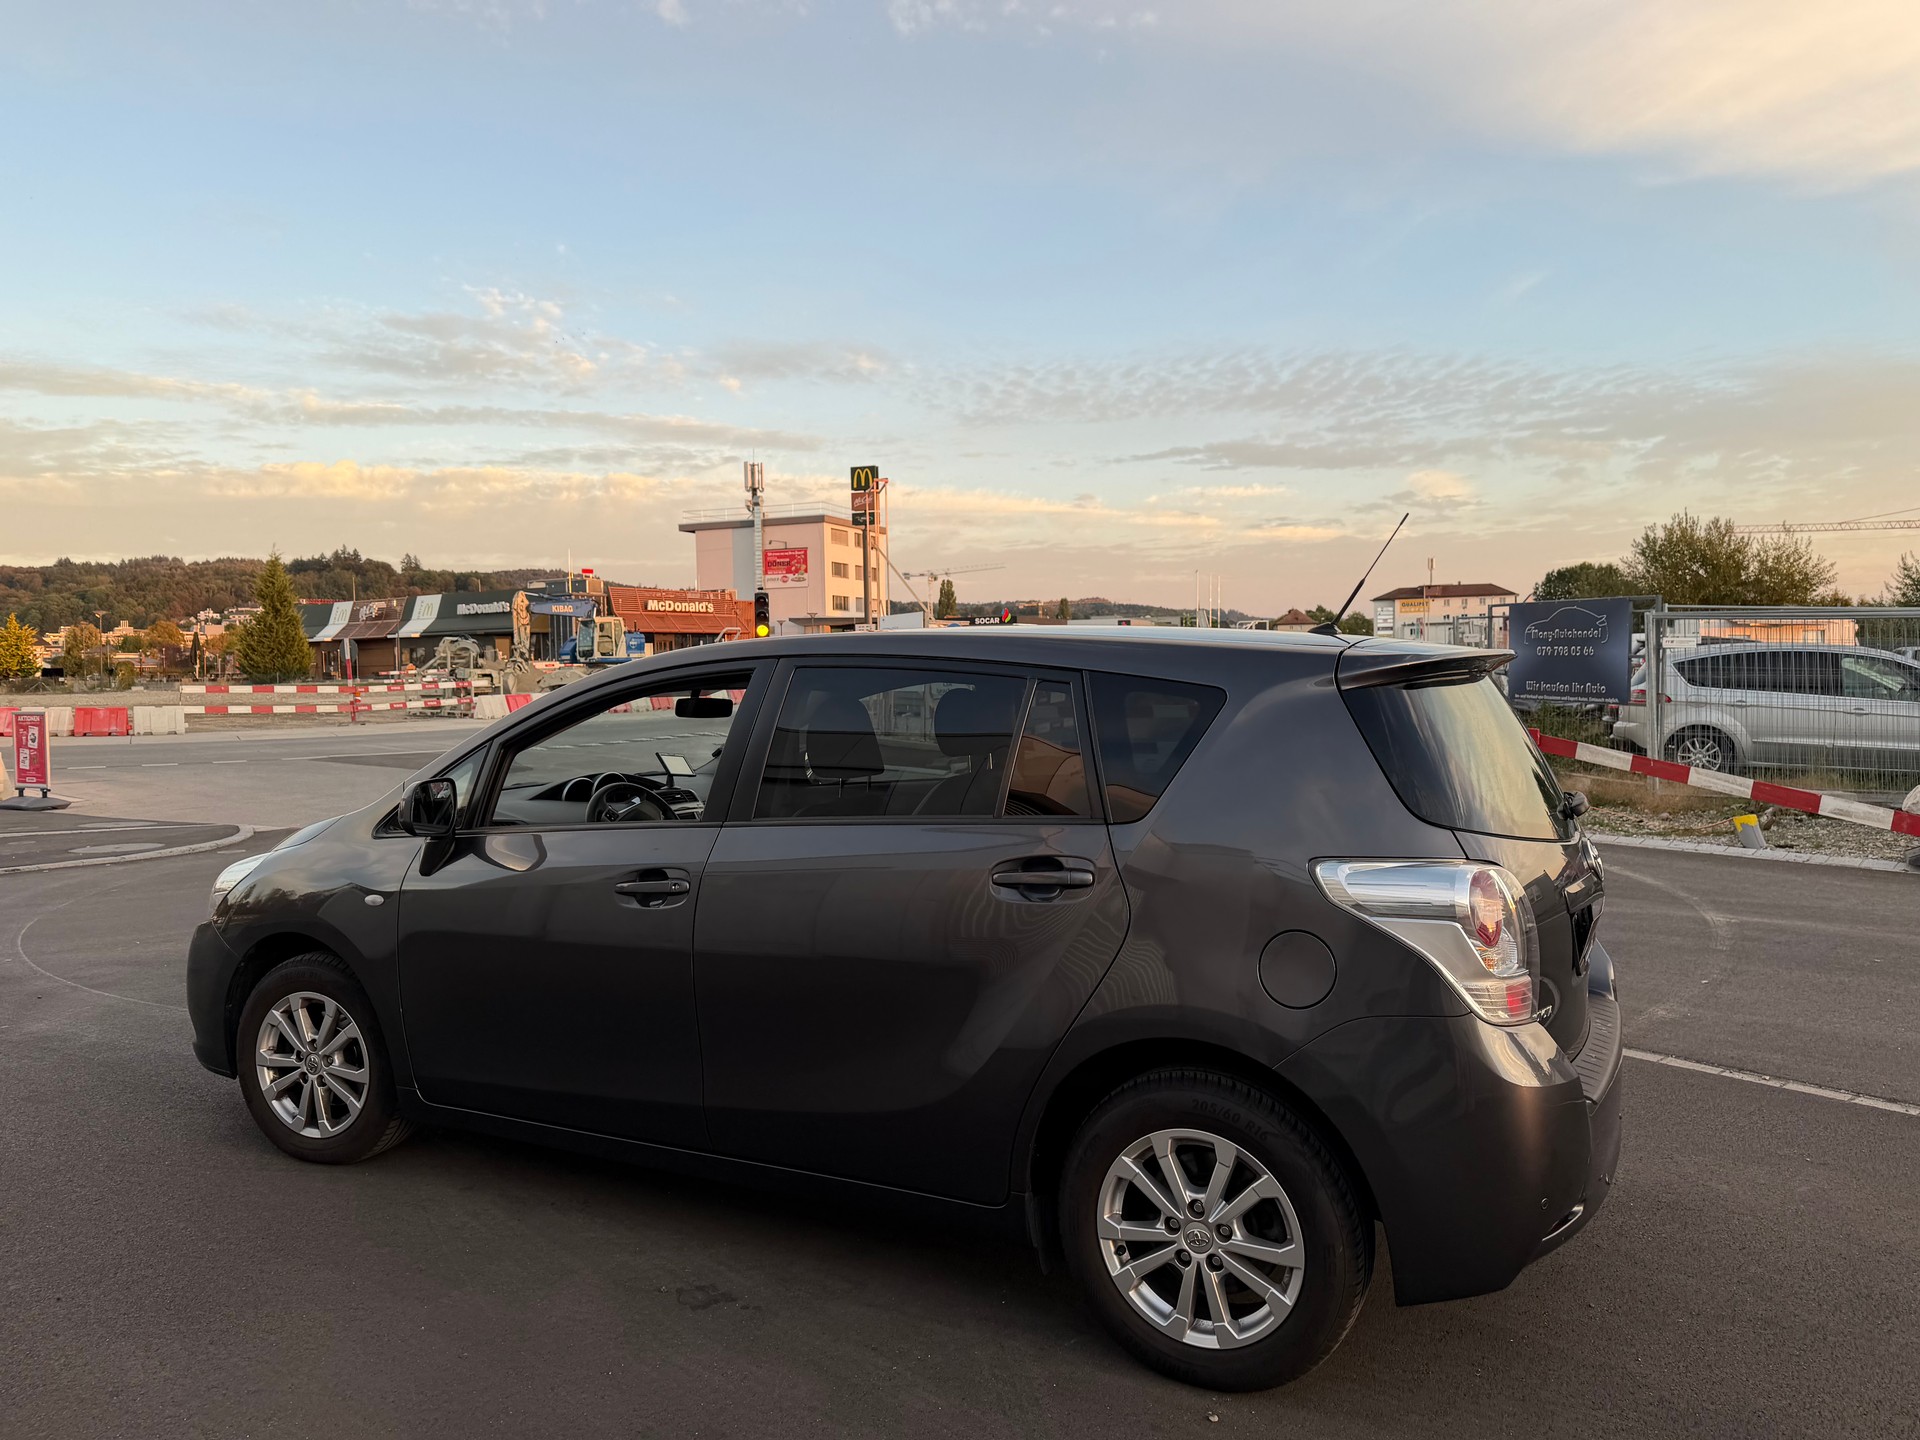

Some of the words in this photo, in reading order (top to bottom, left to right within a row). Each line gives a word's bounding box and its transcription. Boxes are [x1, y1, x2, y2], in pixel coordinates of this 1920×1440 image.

[456, 601, 510, 615] McDonald's
[647, 599, 714, 613] McDonald's
[1553, 646, 1569, 656] 798
[1570, 646, 1581, 656] 05
[1583, 646, 1594, 656] 66
[1526, 680, 1539, 691] Wir
[1541, 681, 1569, 692] kaufen
[1571, 682, 1586, 693] Ihr
[1586, 682, 1606, 694] Auto
[1192, 1098, 1241, 1124] 205/60
[1244, 1119, 1268, 1141] R16
